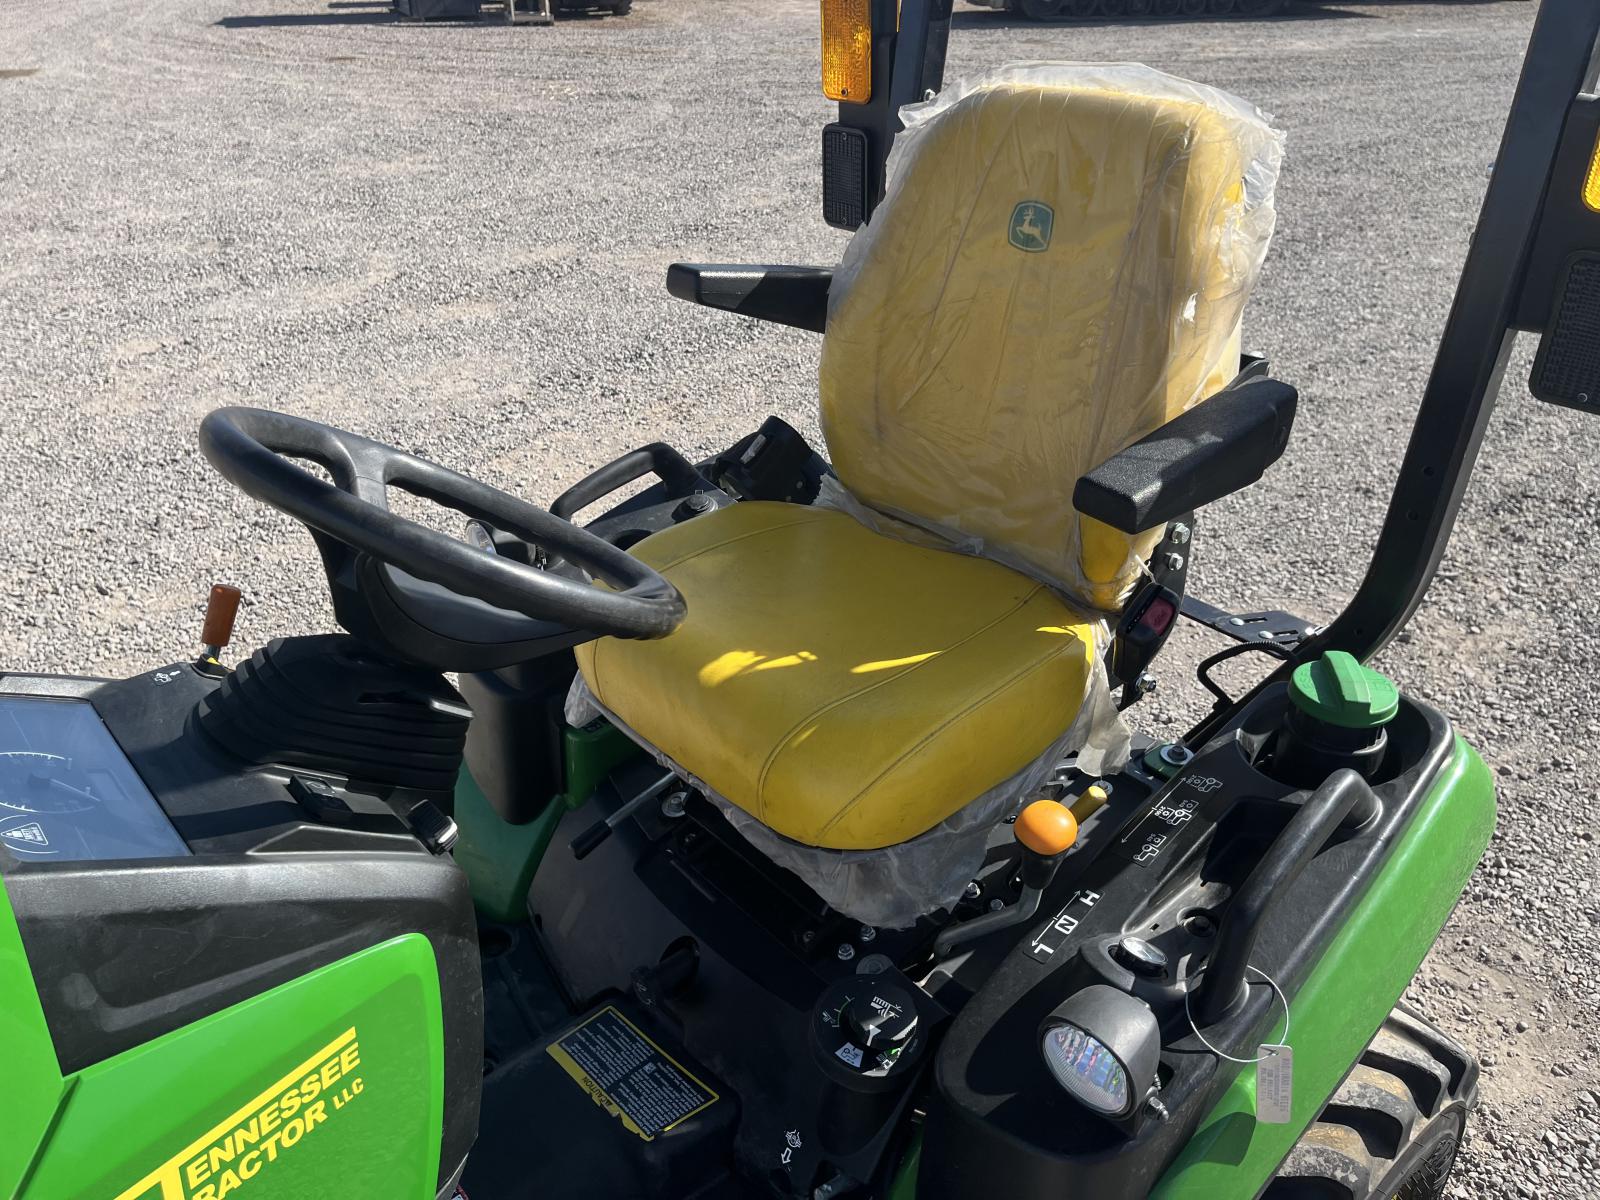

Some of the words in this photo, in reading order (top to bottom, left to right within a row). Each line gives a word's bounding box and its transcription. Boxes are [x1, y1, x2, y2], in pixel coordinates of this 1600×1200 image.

[1079, 889, 1101, 907] H
[1033, 943, 1055, 954] L
[332, 1077, 365, 1110] LLC
[581, 1076, 608, 1102] CAUTION
